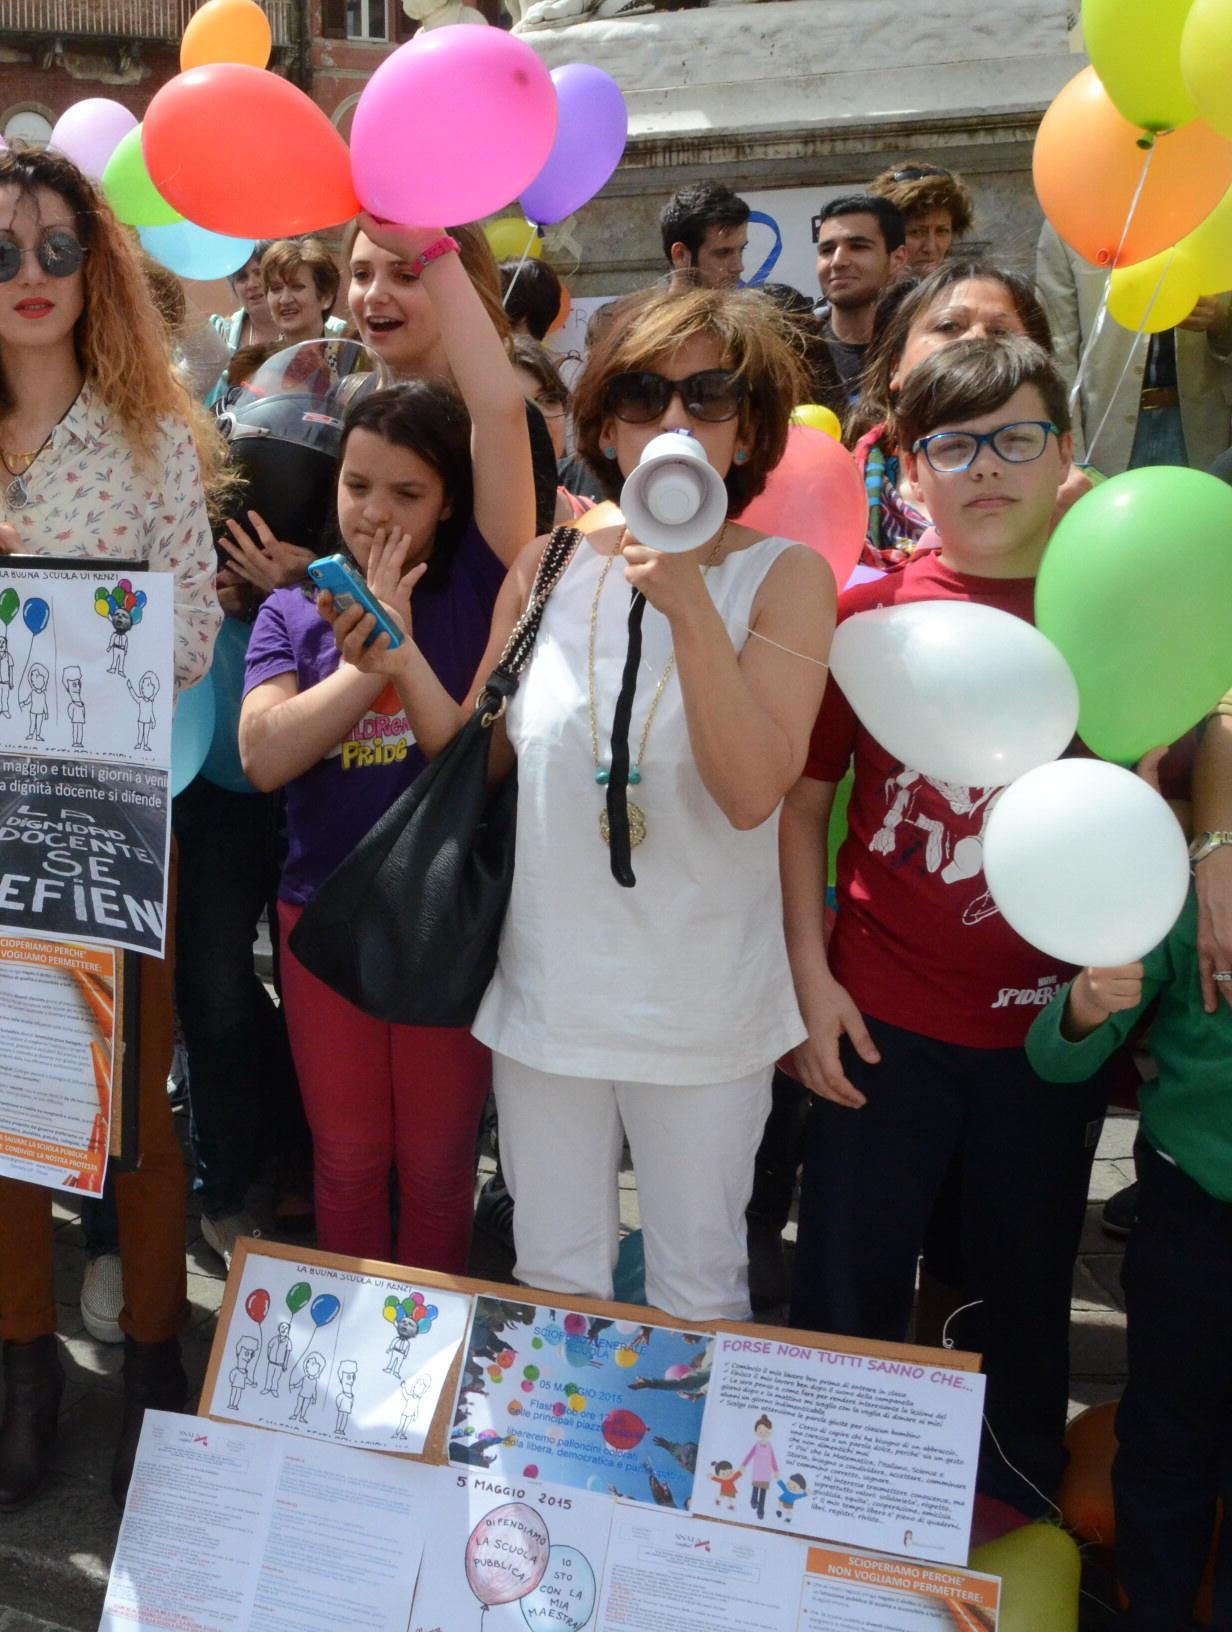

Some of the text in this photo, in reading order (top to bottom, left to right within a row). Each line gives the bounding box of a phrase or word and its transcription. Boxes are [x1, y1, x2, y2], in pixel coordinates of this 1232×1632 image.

[3, 760, 48, 778] maggio
[51, 766, 58, 776] e
[62, 764, 88, 777] tutti
[98, 767, 132, 784] giorni
[135, 774, 142, 784] a
[10, 779, 52, 798] dignità
[55, 784, 106, 800] docente
[108, 789, 118, 801] si
[122, 790, 162, 808] difende
[17, 804, 96, 823] LA
[42, 850, 120, 886] SE
[2, 948, 47, 963] VOGLIAMO
[991, 983, 1061, 1009] SPIDER-
[723, 1340, 974, 1393] FORSE NON TUTTI SANNO CHE...
[457, 1476, 573, 1511] 5 MAGGIO 2015
[486, 1518, 547, 1546] DIFENDIAMO
[476, 1537, 538, 1566] LA SCUOLA
[562, 1558, 572, 1568] IO
[553, 1571, 574, 1582] STO
[848, 1556, 920, 1578] SCIOPERIAMO
[539, 1584, 584, 1601] CON LA
[827, 1564, 984, 1604] NON VOGLIAMO PERMETTERE:
[550, 1598, 570, 1612] MIA
